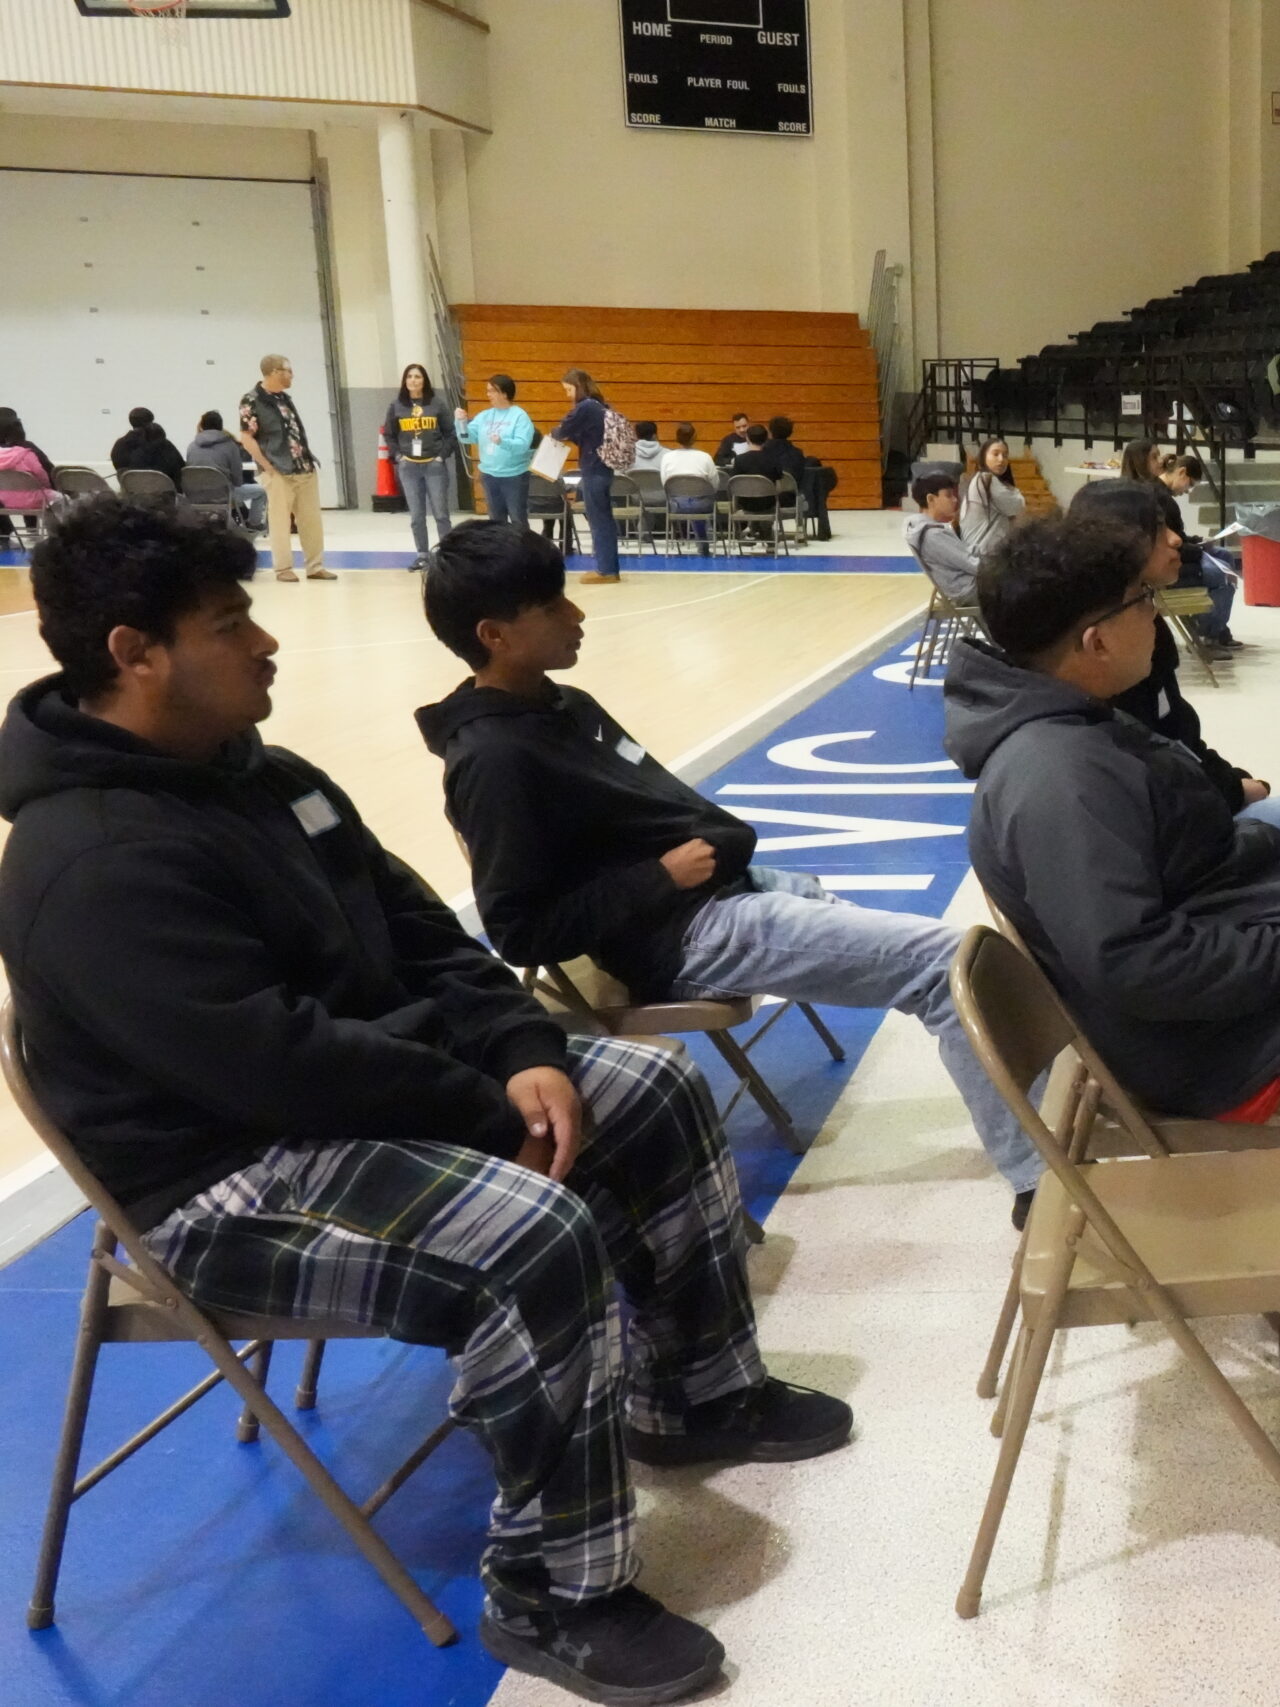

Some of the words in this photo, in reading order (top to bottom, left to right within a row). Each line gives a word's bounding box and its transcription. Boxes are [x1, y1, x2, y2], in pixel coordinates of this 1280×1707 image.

[632, 21, 672, 37] HOME
[700, 34, 733, 45] PERIOD
[757, 31, 800, 46] GUEST
[628, 73, 658, 84] FOULS
[687, 76, 722, 89] PLAYER
[726, 79, 750, 90] FOUL
[777, 83, 806, 94] FOULS
[630, 112, 661, 124] SCORE
[705, 117, 736, 128] MATCH
[778, 121, 807, 132] SCORE
